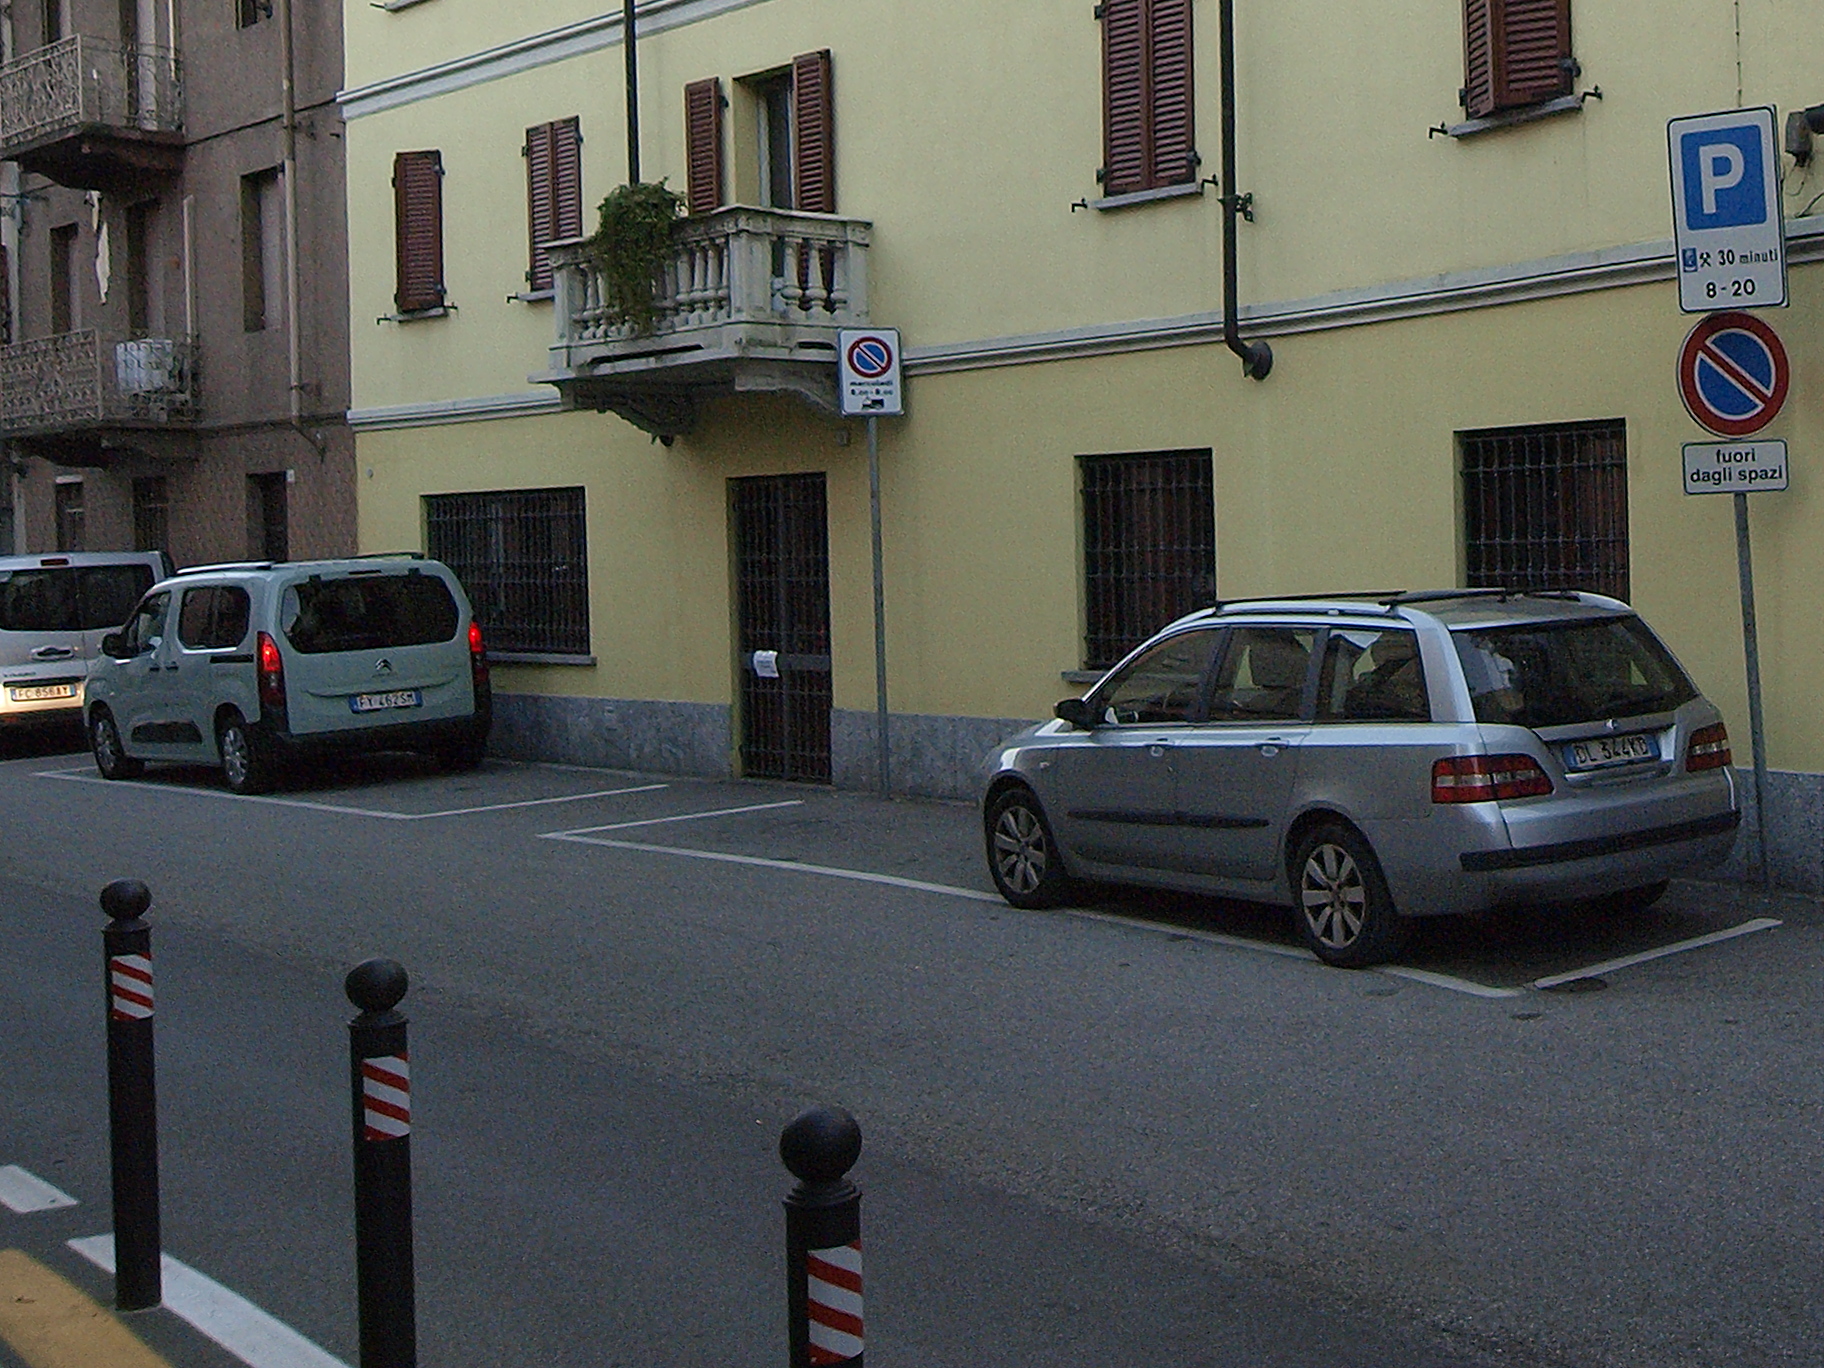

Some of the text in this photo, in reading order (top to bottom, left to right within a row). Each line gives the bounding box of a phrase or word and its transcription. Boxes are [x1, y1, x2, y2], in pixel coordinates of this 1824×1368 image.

[1700, 143, 1744, 215] P
[1718, 248, 1778, 266] 30 minuti
[1716, 448, 1756, 464] fuori
[1690, 465, 1782, 485] dagli spazi
